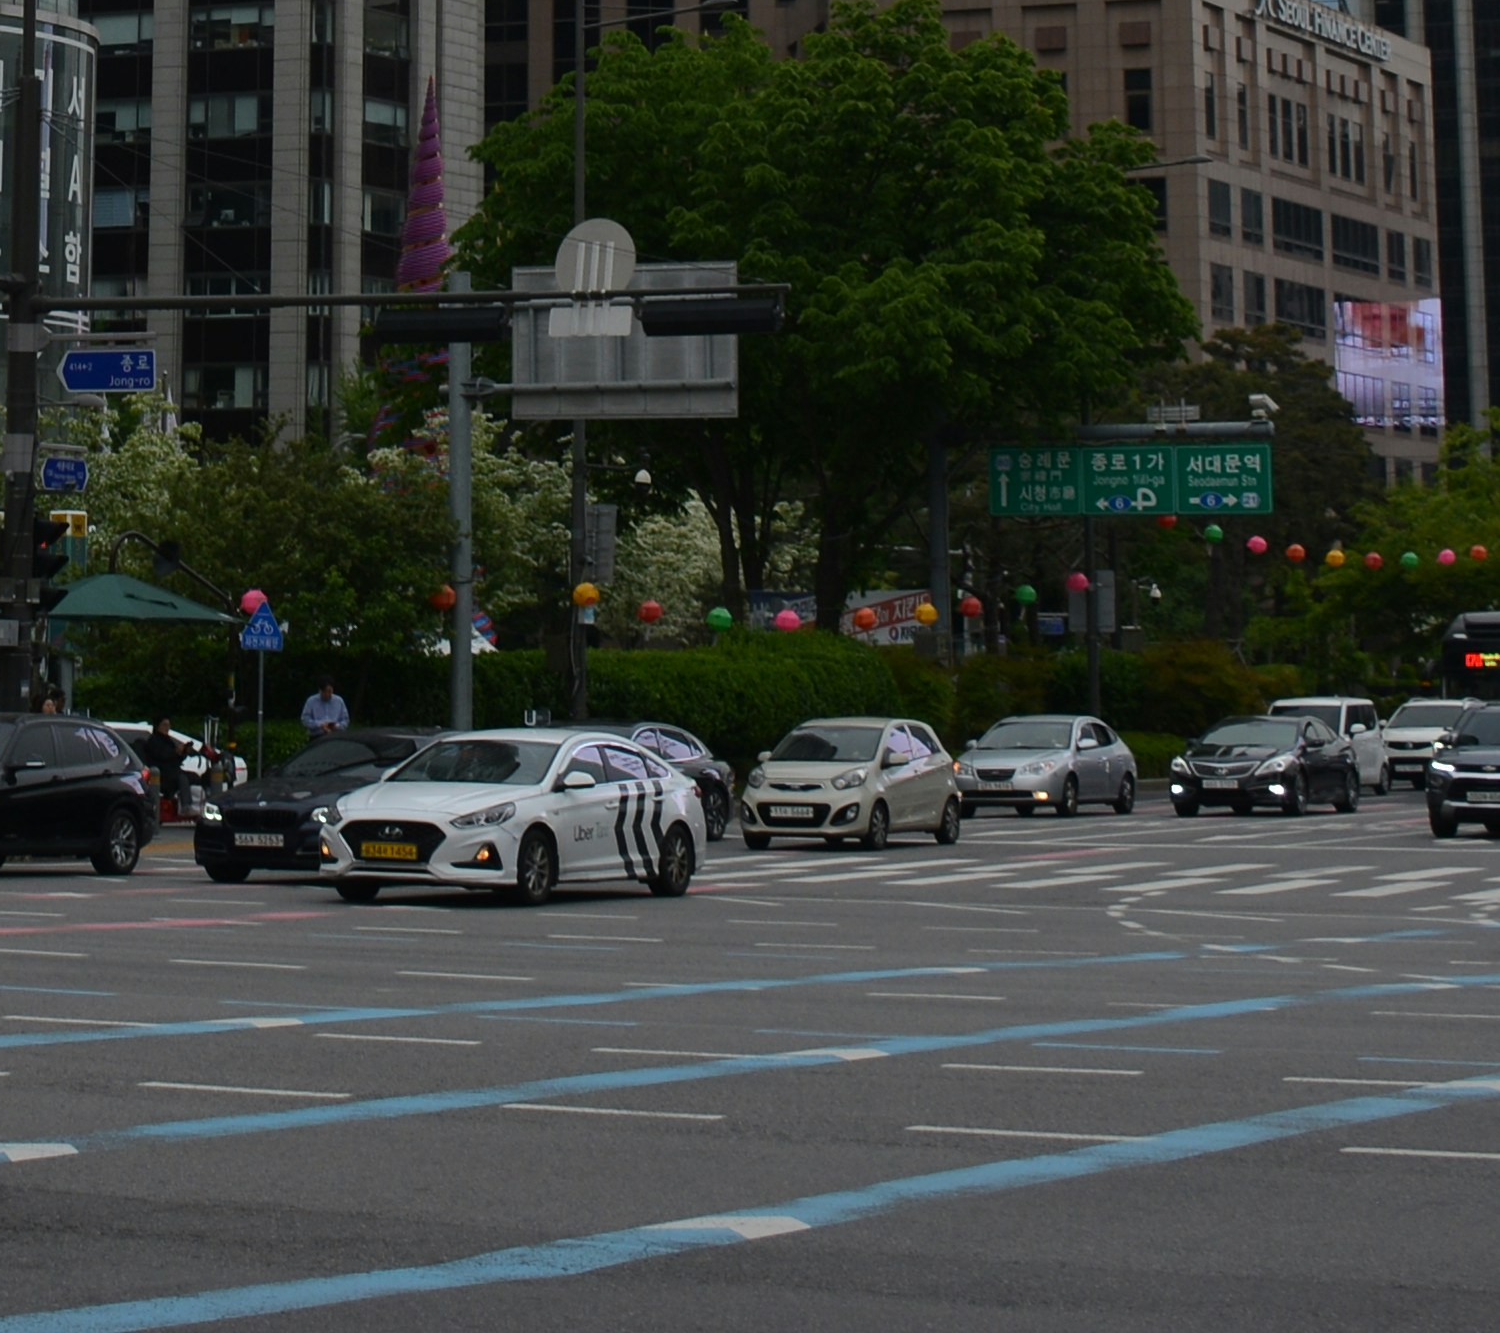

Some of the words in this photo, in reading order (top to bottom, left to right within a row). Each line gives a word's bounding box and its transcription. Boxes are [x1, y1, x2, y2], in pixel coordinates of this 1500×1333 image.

[1314, 7, 1358, 50] FINANCE
[1357, 23, 1392, 61] CENTER
[120, 354, 151, 373] 종로
[109, 375, 151, 389] Jong-ro
[1186, 453, 1261, 474] 서대문역
[1092, 475, 1129, 488] Jongno
[1019, 484, 1047, 502] 시청
[573, 825, 594, 842] Uber
